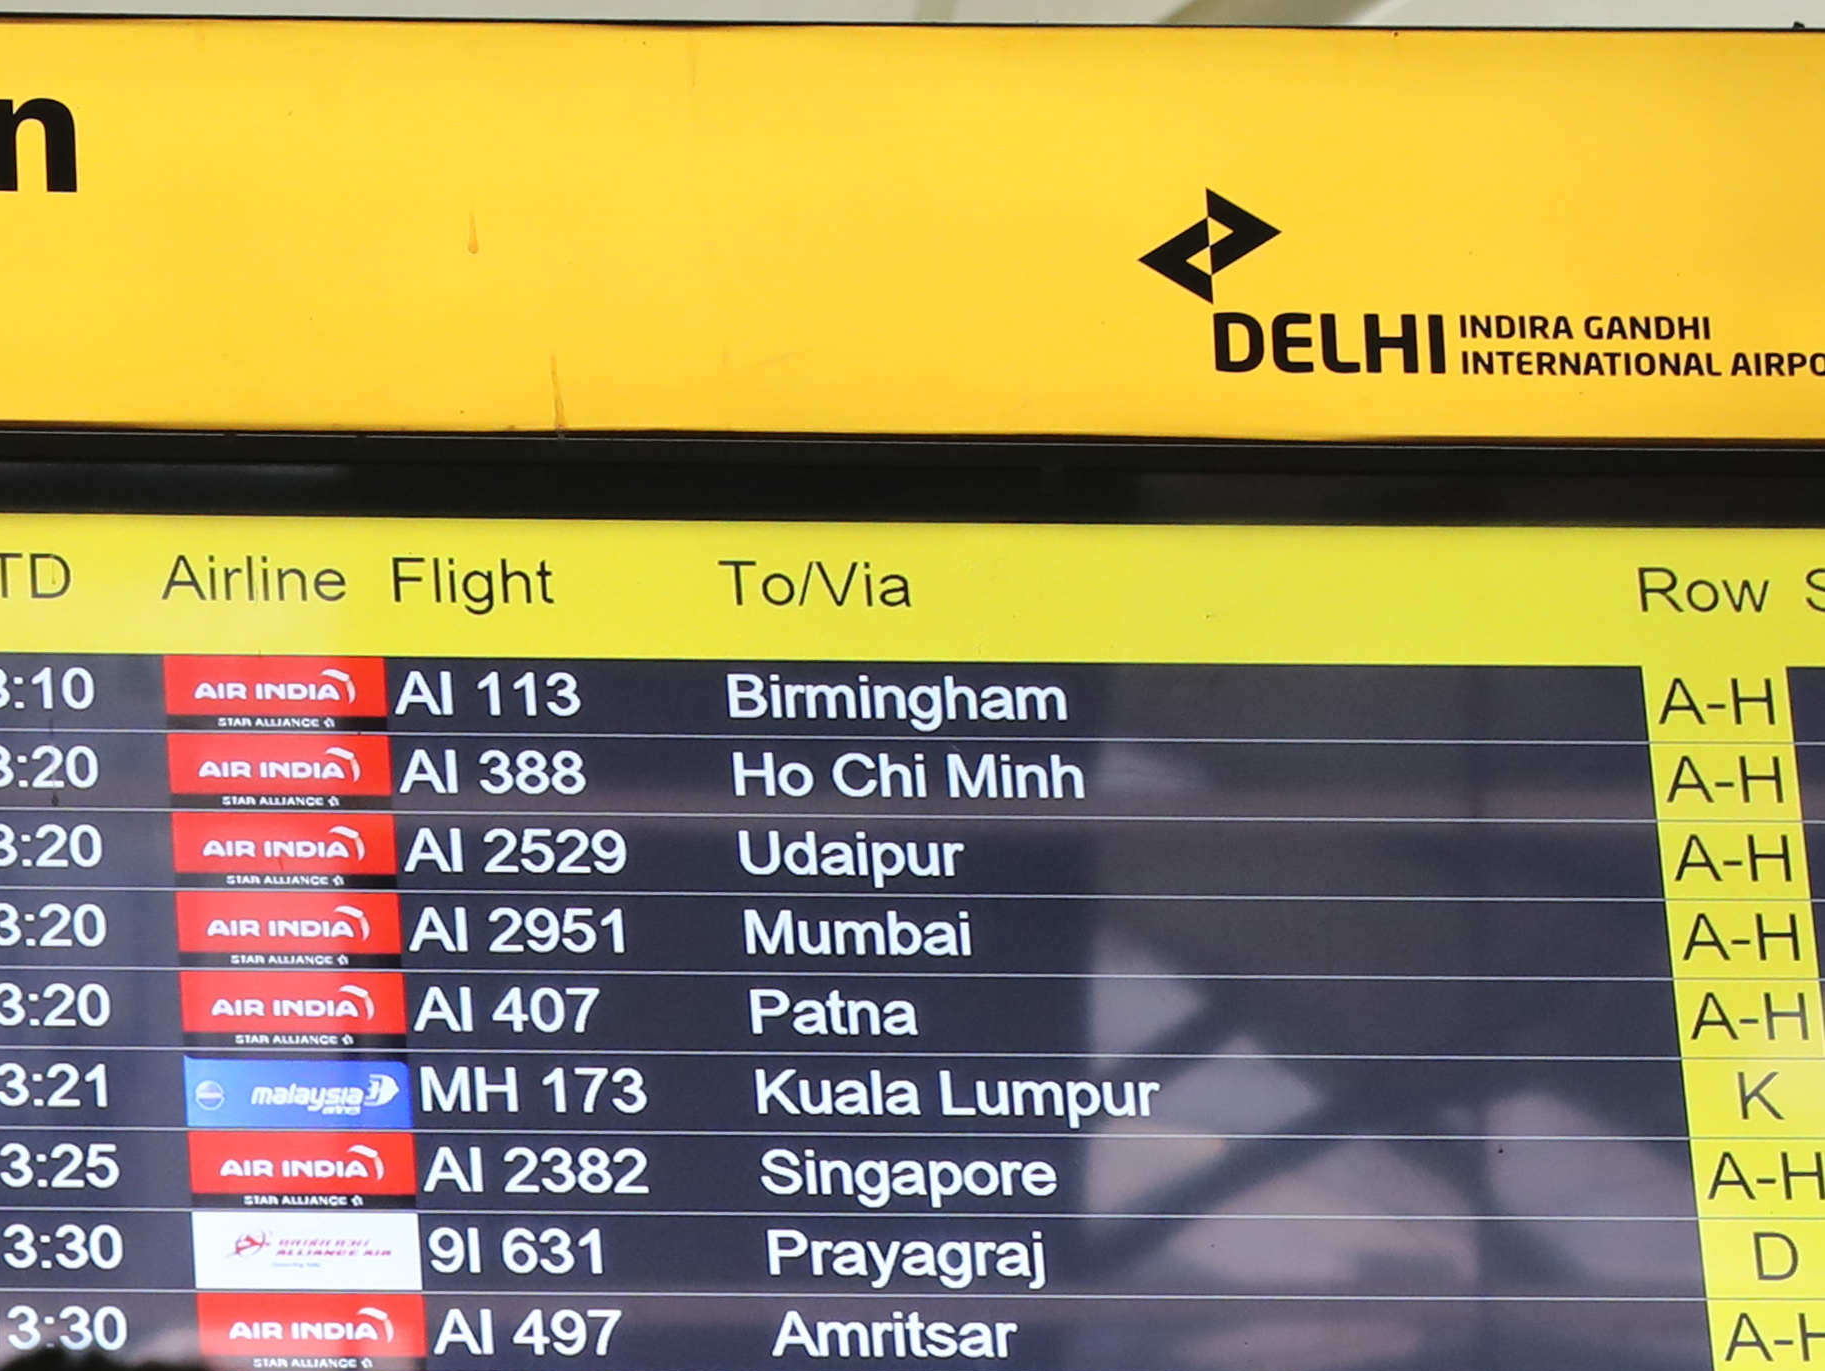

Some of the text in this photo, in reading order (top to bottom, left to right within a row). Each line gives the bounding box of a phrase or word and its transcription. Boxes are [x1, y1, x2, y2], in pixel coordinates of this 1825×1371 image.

[1213, 312, 1446, 374] DELHI
[1460, 315, 1710, 340] INDIRA GANDHI
[1462, 351, 1722, 376] INTERNATIONAL
[162, 555, 346, 601] Airline
[393, 557, 554, 615] Flight
[718, 561, 911, 607] To/Via
[1638, 567, 1769, 612] Row
[395, 671, 453, 715] AI
[478, 672, 580, 716] 113
[727, 674, 1067, 731] Birmingham
[1659, 678, 1775, 725] A-H
[733, 752, 1085, 798] Ho Chi Minh
[251, 1083, 364, 1111] malaysia
[421, 1066, 518, 1112] MH
[543, 1068, 647, 1113] 173
[756, 1069, 921, 1115] Kuala
[933, 1071, 1166, 1135] Lumpur
[1738, 1072, 1784, 1120] K
[503, 1228, 1798, 1289] 631 Prayagraj D
